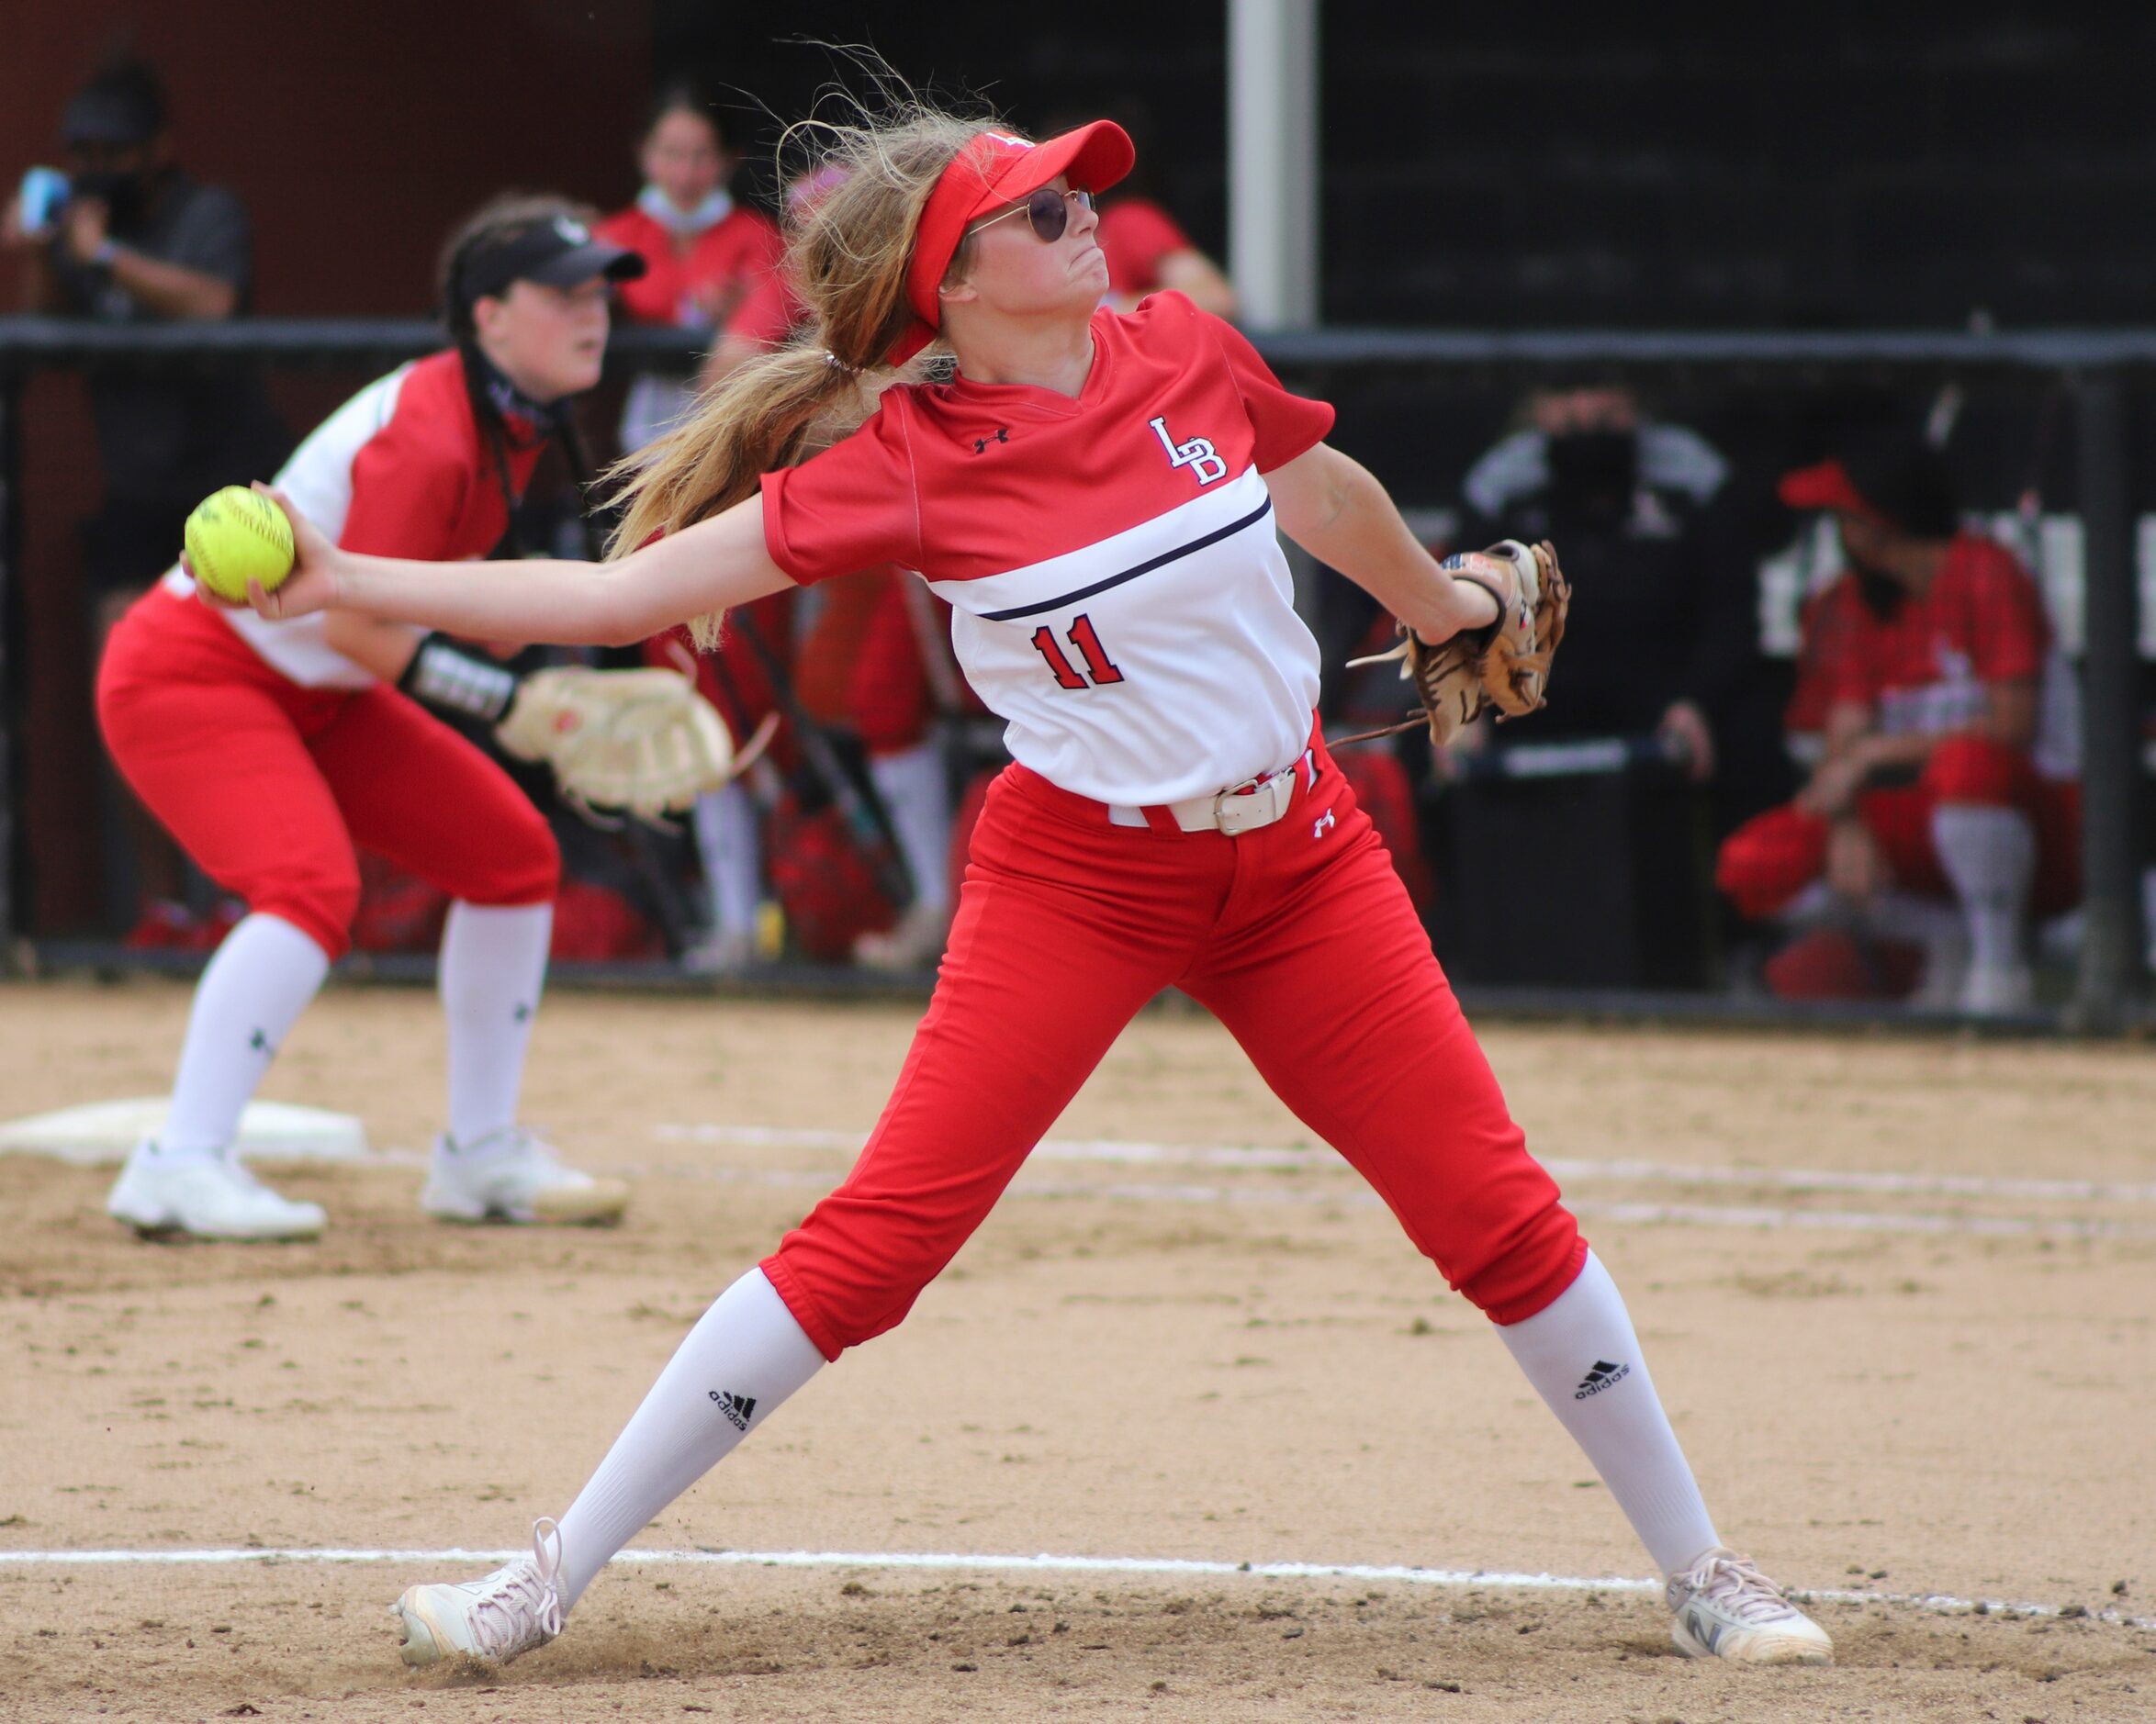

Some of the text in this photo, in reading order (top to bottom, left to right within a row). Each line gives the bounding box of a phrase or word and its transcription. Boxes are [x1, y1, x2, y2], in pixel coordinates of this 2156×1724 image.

[1149, 415, 1228, 487] LB
[1030, 613, 1125, 689] 11
[1575, 1363, 1630, 1400] adidas
[709, 1391, 747, 1431] adidas
